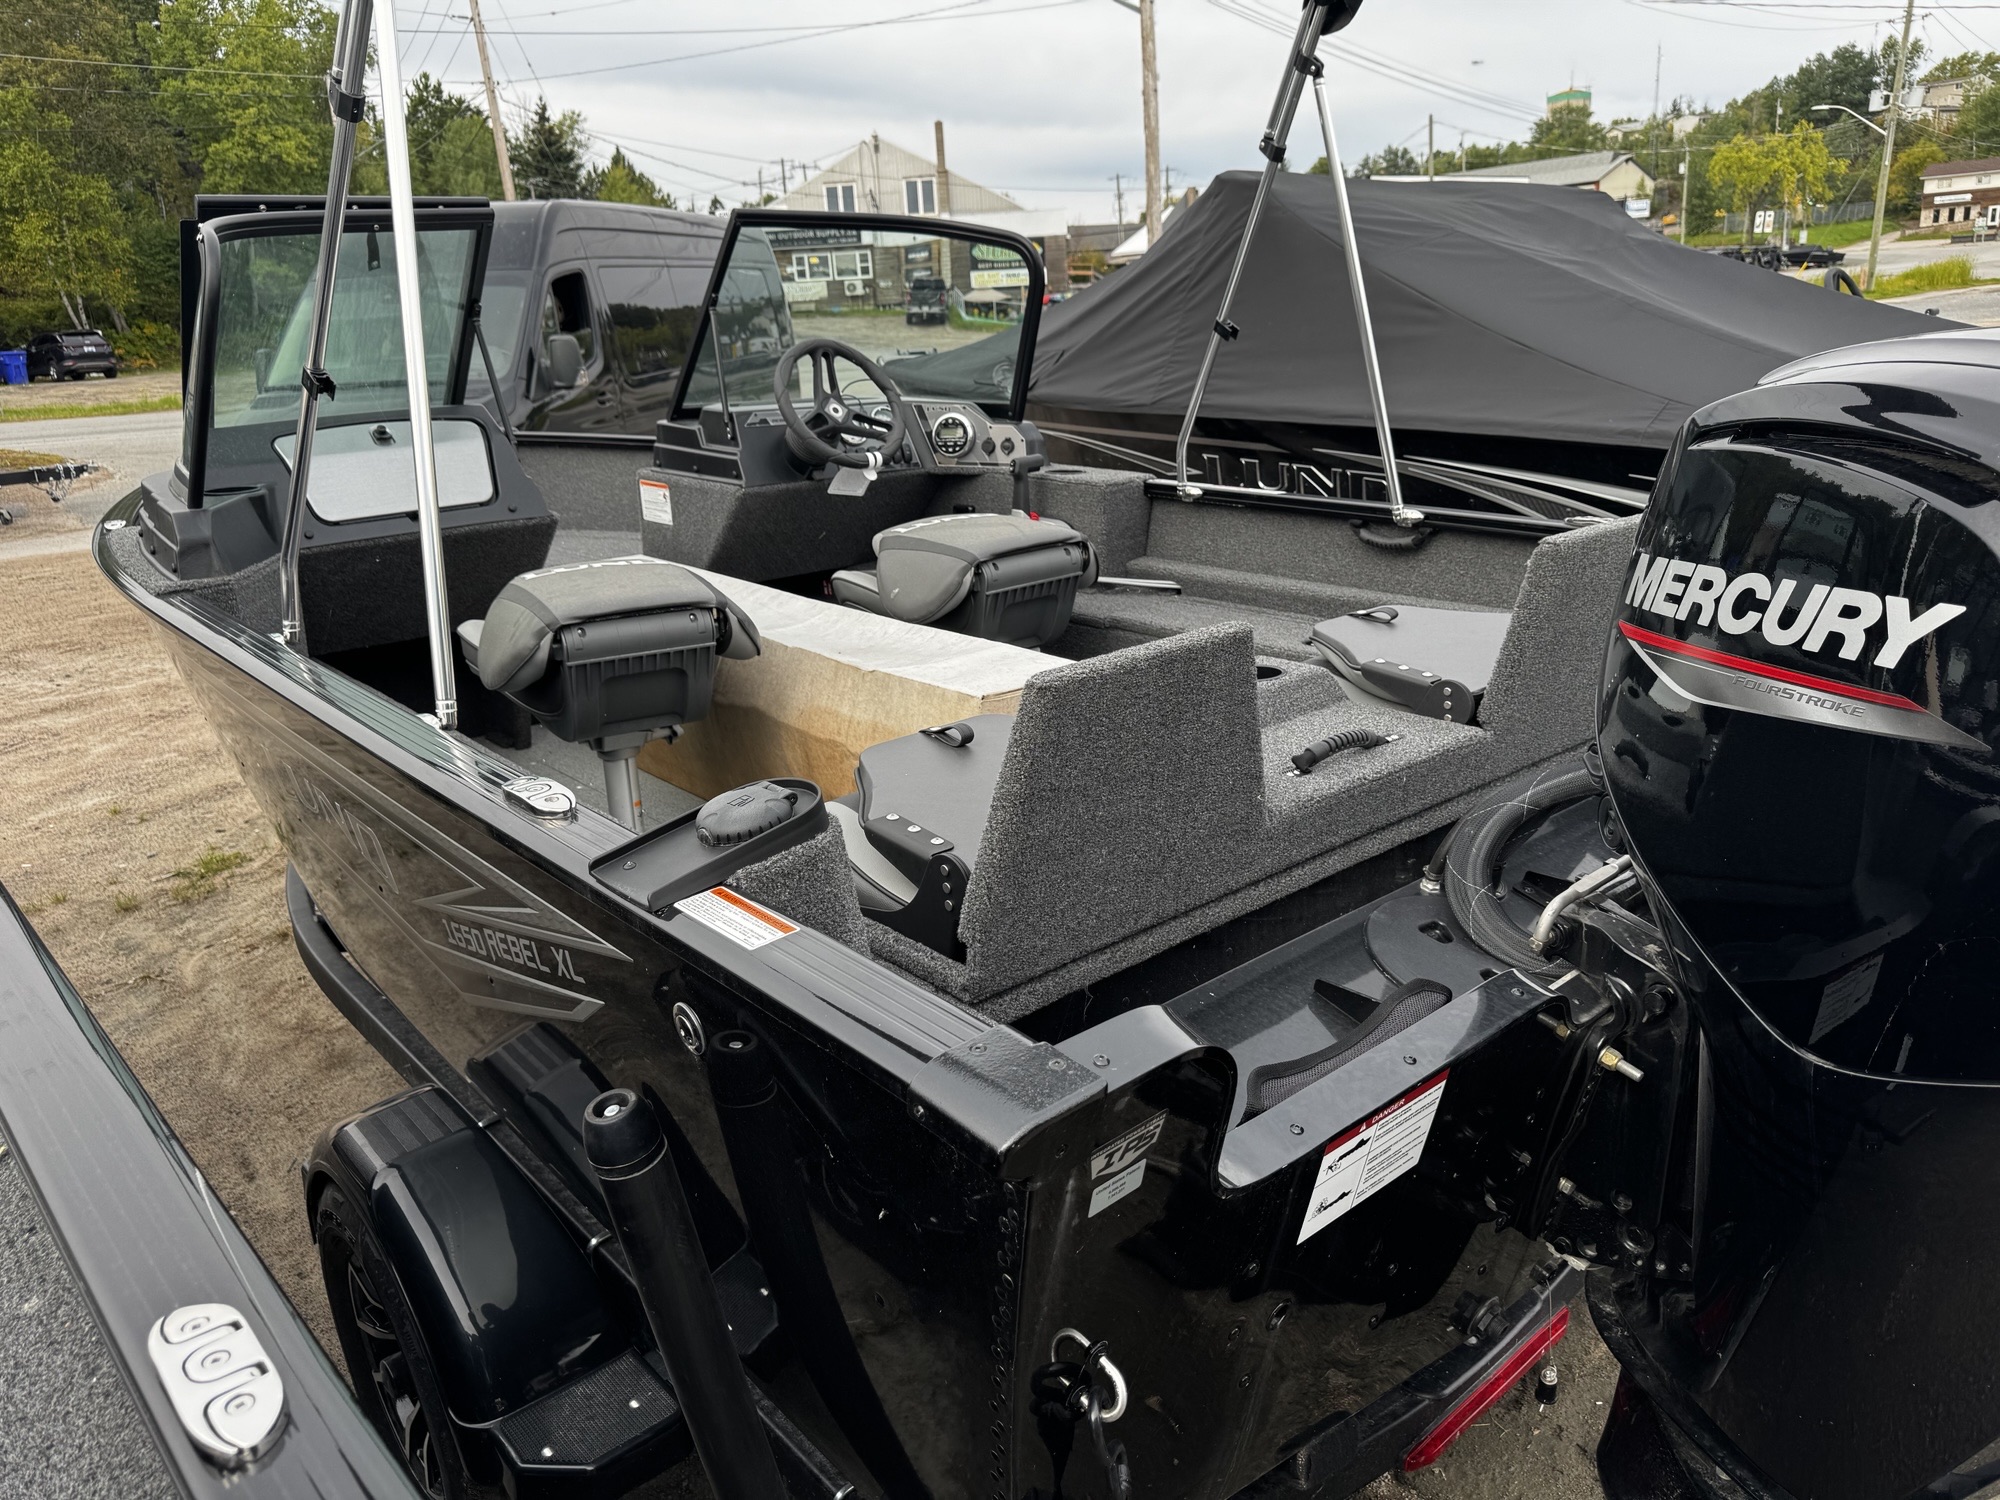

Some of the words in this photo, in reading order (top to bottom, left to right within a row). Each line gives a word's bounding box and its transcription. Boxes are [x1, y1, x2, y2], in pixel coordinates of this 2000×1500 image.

[1625, 553, 1967, 669] MERCURY
[1732, 674, 1866, 718] FOURSTROKE
[442, 918, 487, 956] 1650
[483, 927, 551, 973] REBEL
[550, 946, 586, 984] XL
[1371, 1098, 1406, 1123] DANGER
[1096, 1123, 1161, 1176] IPS
